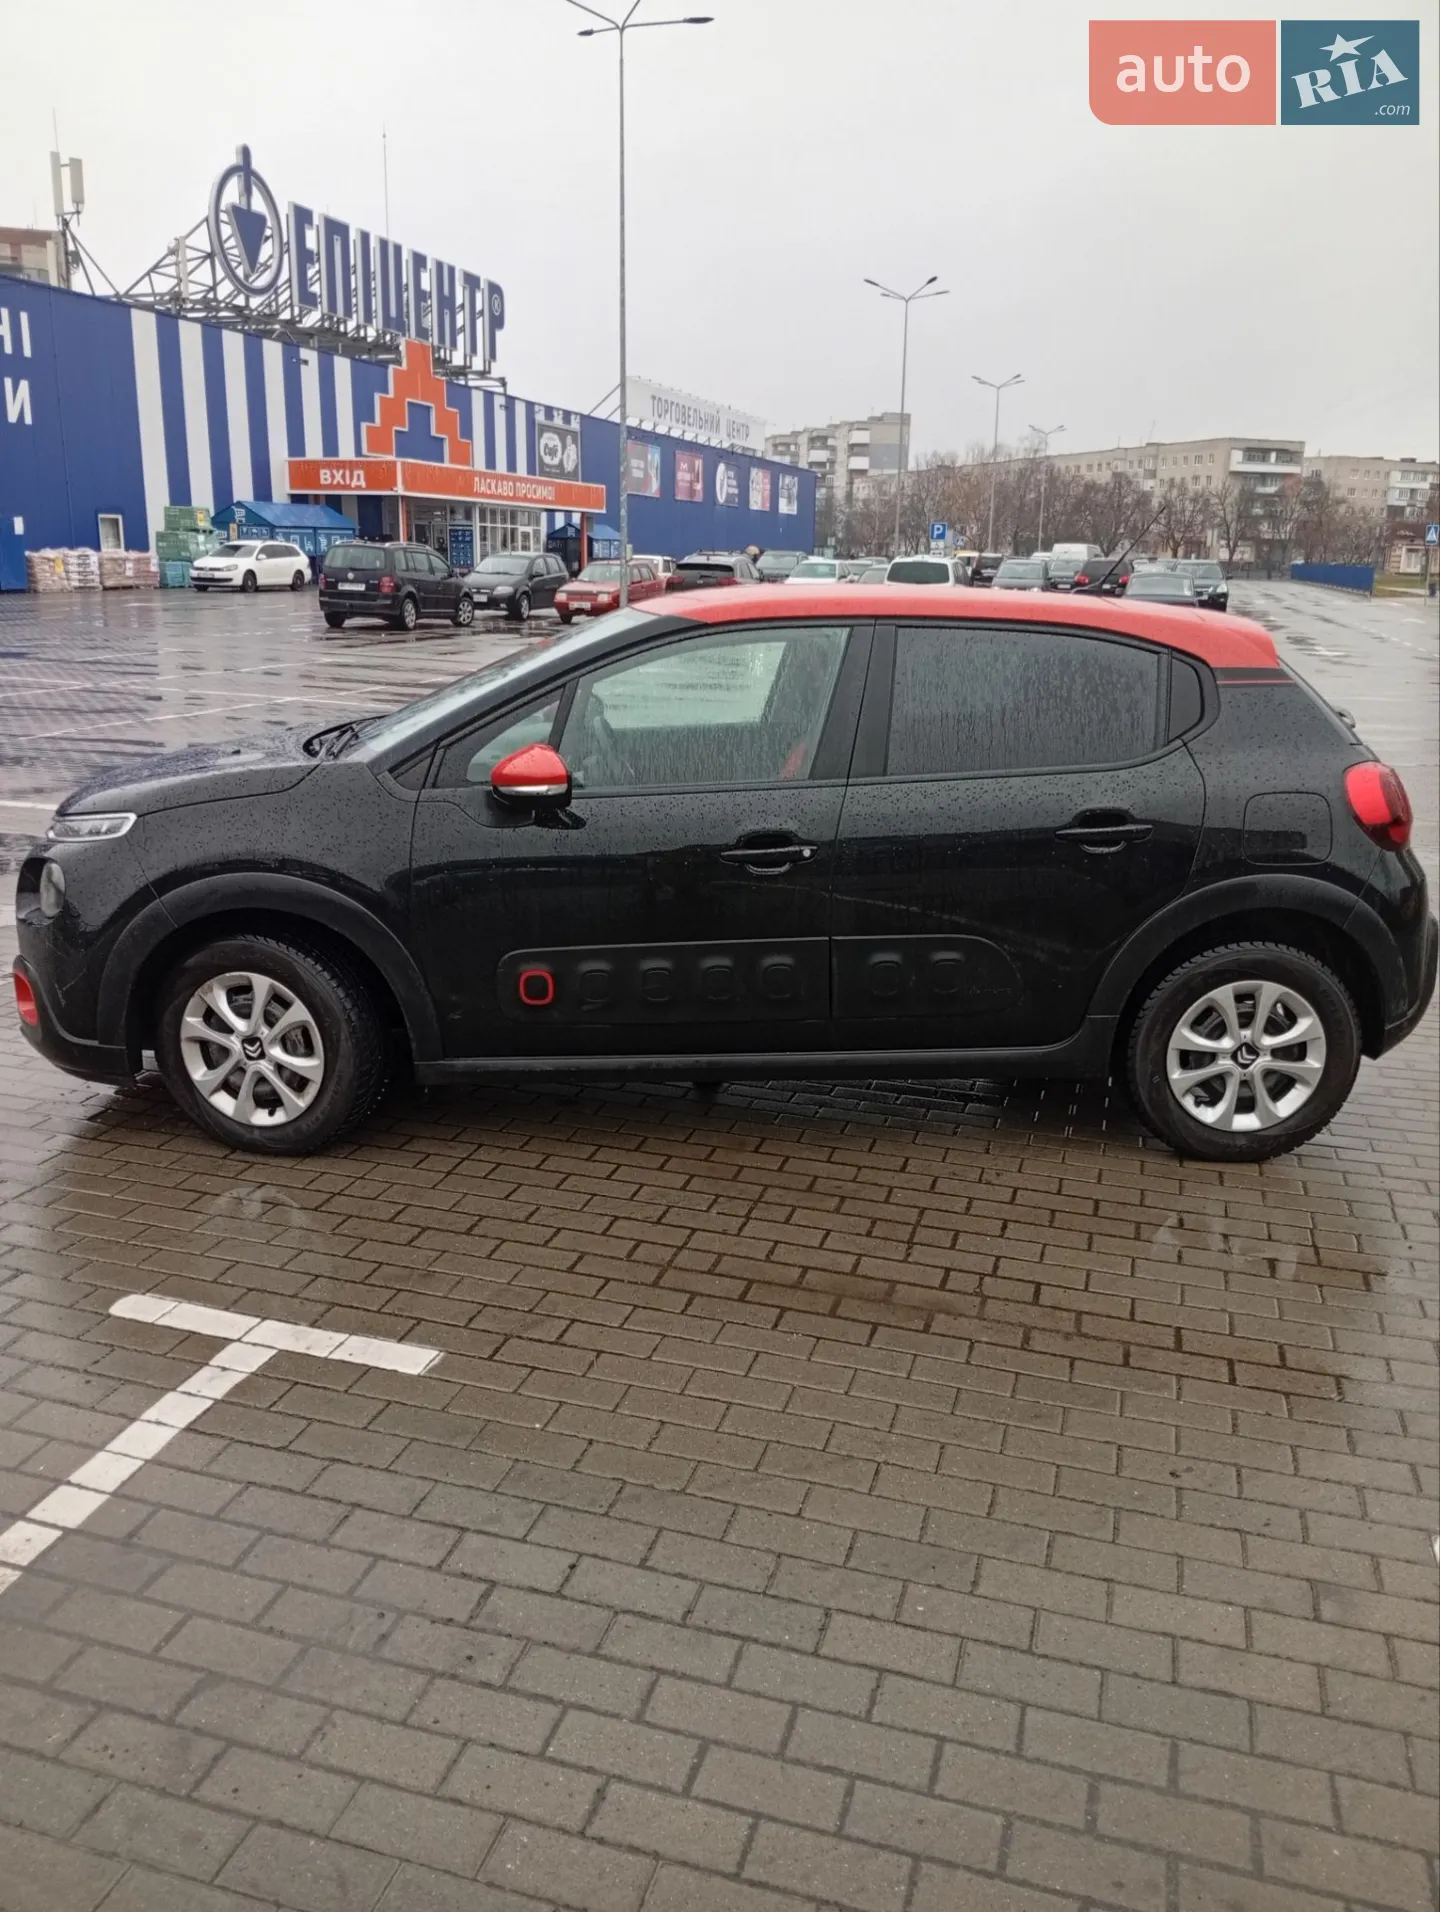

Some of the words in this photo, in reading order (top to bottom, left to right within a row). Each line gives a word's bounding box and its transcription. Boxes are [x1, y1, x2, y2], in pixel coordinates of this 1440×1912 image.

[288, 201, 505, 363] ЕПІЦЕНТР
[651, 394, 721, 435] ТОРГОВЕЛЬНИЙ
[726, 416, 750, 442] ЦЕНТР
[319, 468, 367, 489] ВХІД
[474, 476, 515, 497] ЛАСКАВО
[515, 480, 556, 501] ПРОСИМО!
[933, 524, 944, 539] P
